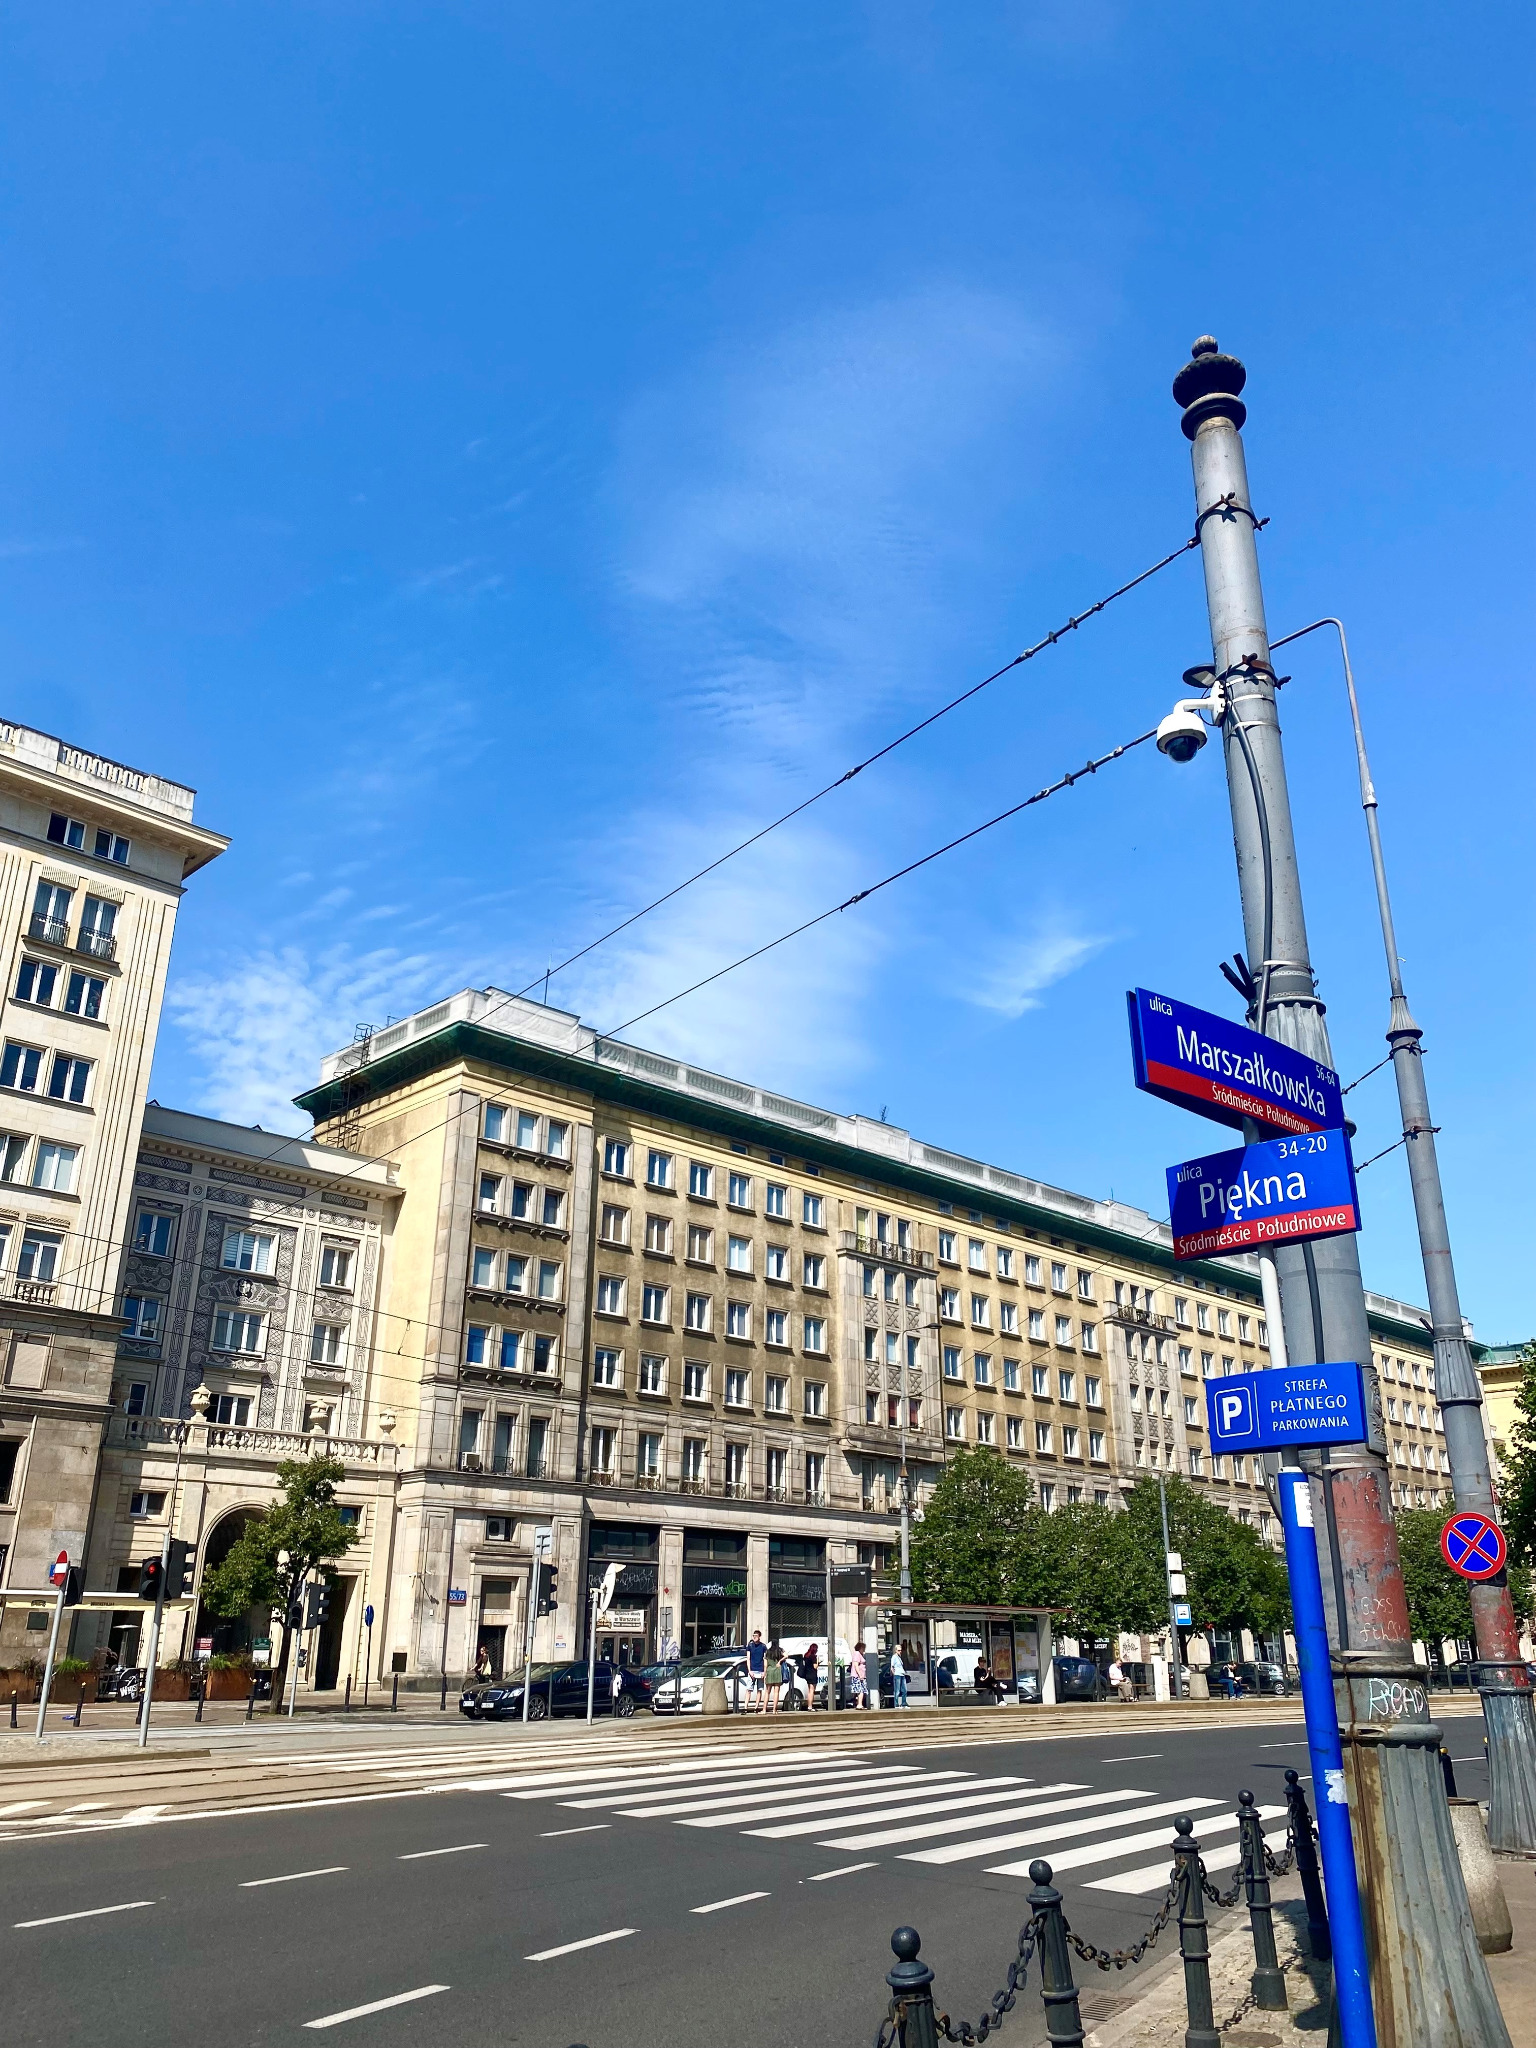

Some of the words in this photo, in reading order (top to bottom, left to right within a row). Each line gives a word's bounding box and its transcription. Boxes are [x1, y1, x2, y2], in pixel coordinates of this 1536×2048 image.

[1149, 996, 1173, 1016] ulica
[1176, 1025, 1327, 1117] Marszałkowska
[1315, 1064, 1336, 1087] 56-64
[1211, 1081, 1264, 1117] Śródmieście
[1266, 1106, 1310, 1135] Południowe
[1277, 1135, 1328, 1159] 34-20
[1176, 1166, 1203, 1183] ulica
[1199, 1170, 1307, 1221] Piękna
[1179, 1225, 1251, 1255] Śródmieście
[1256, 1212, 1347, 1238] Południowe
[1284, 1378, 1328, 1393] STREFA
[1221, 1396, 1243, 1431] P
[1270, 1394, 1348, 1414] PŁATNEGO
[1272, 1415, 1350, 1432] PARKOWANIA
